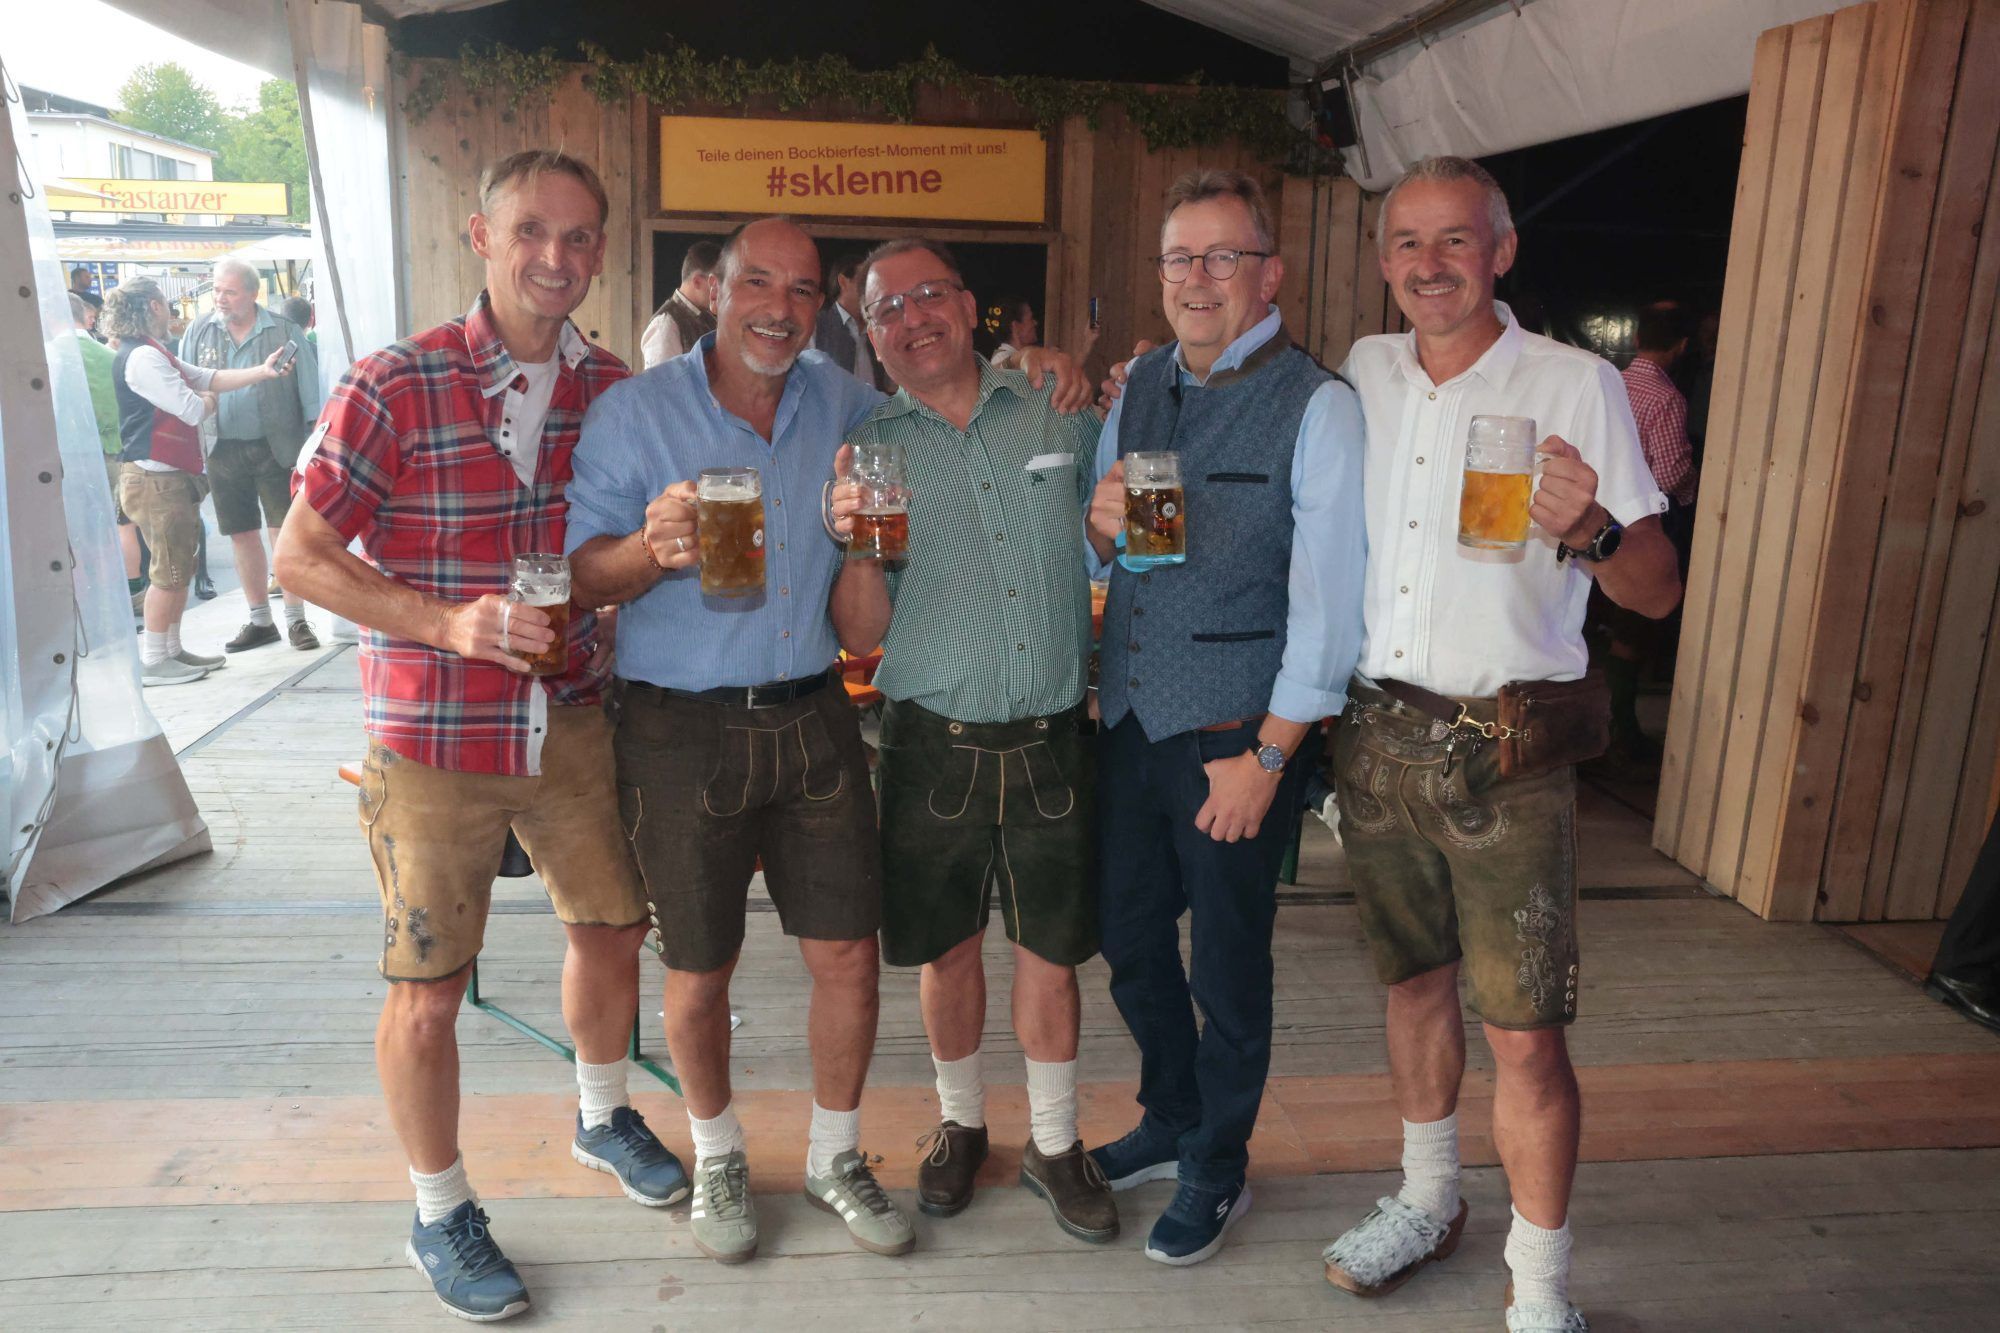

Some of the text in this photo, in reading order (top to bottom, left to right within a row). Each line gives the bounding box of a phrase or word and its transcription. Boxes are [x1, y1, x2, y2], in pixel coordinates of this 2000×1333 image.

[696, 141, 1008, 162] Teile deinen Bockbierfest-Moment mit uns!
[766, 163, 943, 198] #sklenne
[98, 182, 228, 211] frastanzer
